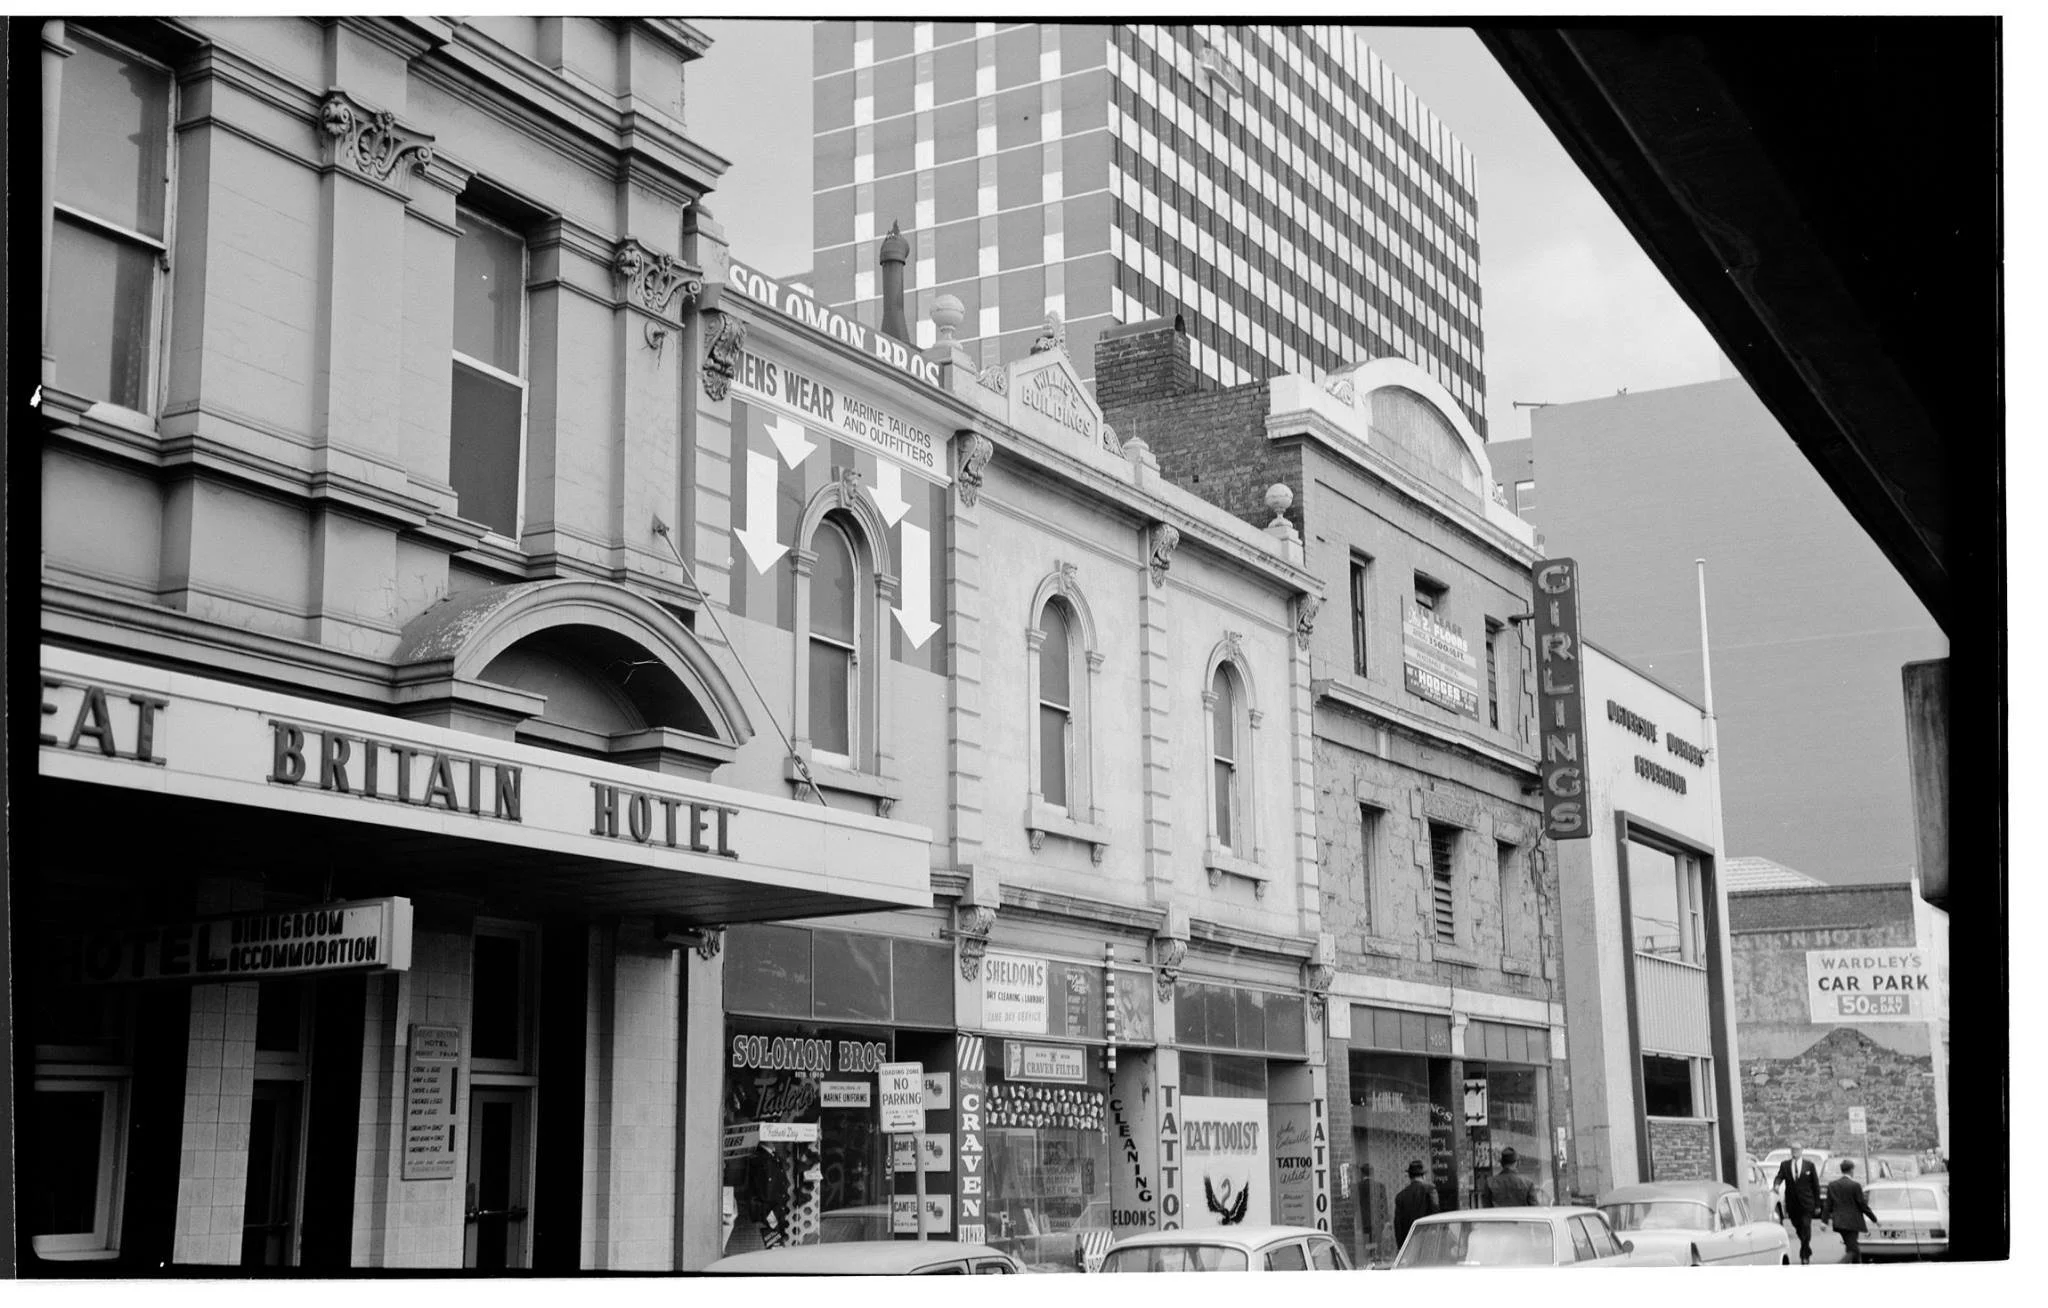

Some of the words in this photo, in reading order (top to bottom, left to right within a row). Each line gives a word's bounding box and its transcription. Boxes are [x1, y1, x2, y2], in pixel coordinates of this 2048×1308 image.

[729, 264, 866, 349] SOLOMON
[874, 334, 940, 387] BROS
[784, 370, 834, 422] WEAR
[1022, 385, 1090, 438] BUILDINGS
[843, 396, 884, 426] MARINE
[888, 416, 930, 448] TAILORS
[843, 416, 867, 435] AND
[870, 427, 933, 467] OUTFITTERS
[1434, 624, 1467, 652] FLOORS
[1538, 564, 1582, 832] GIRLINGS
[267, 719, 522, 822] BRITAIN
[590, 781, 739, 860] HOTEL
[230, 937, 377, 971] ACCOMMODATION
[1821, 953, 1922, 969] WARDLEY'S
[986, 959, 1044, 986] SHELDON'S
[1818, 975, 1860, 991] CAR
[1873, 974, 1929, 991] PARK
[986, 989, 996, 1000] DRY
[1880, 1003, 1903, 1013] DAY
[733, 1035, 831, 1072] SOLOMON
[839, 1041, 887, 1073] BROS
[1026, 1062, 1054, 1074] CRAVEN
[1055, 1063, 1081, 1076] FILTER
[823, 1093, 842, 1102] MARINE
[843, 1093, 867, 1103] UNIFORMS
[882, 1093, 922, 1106] PARKING
[893, 1077, 909, 1090] NO
[1110, 1099, 1152, 1202] CLEANING
[1184, 1120, 1260, 1152] TATTOOIST
[960, 1094, 984, 1217] CRAVEN
[1276, 1157, 1313, 1169] TATTOO
[1313, 1098, 1328, 1232] TATTOO
